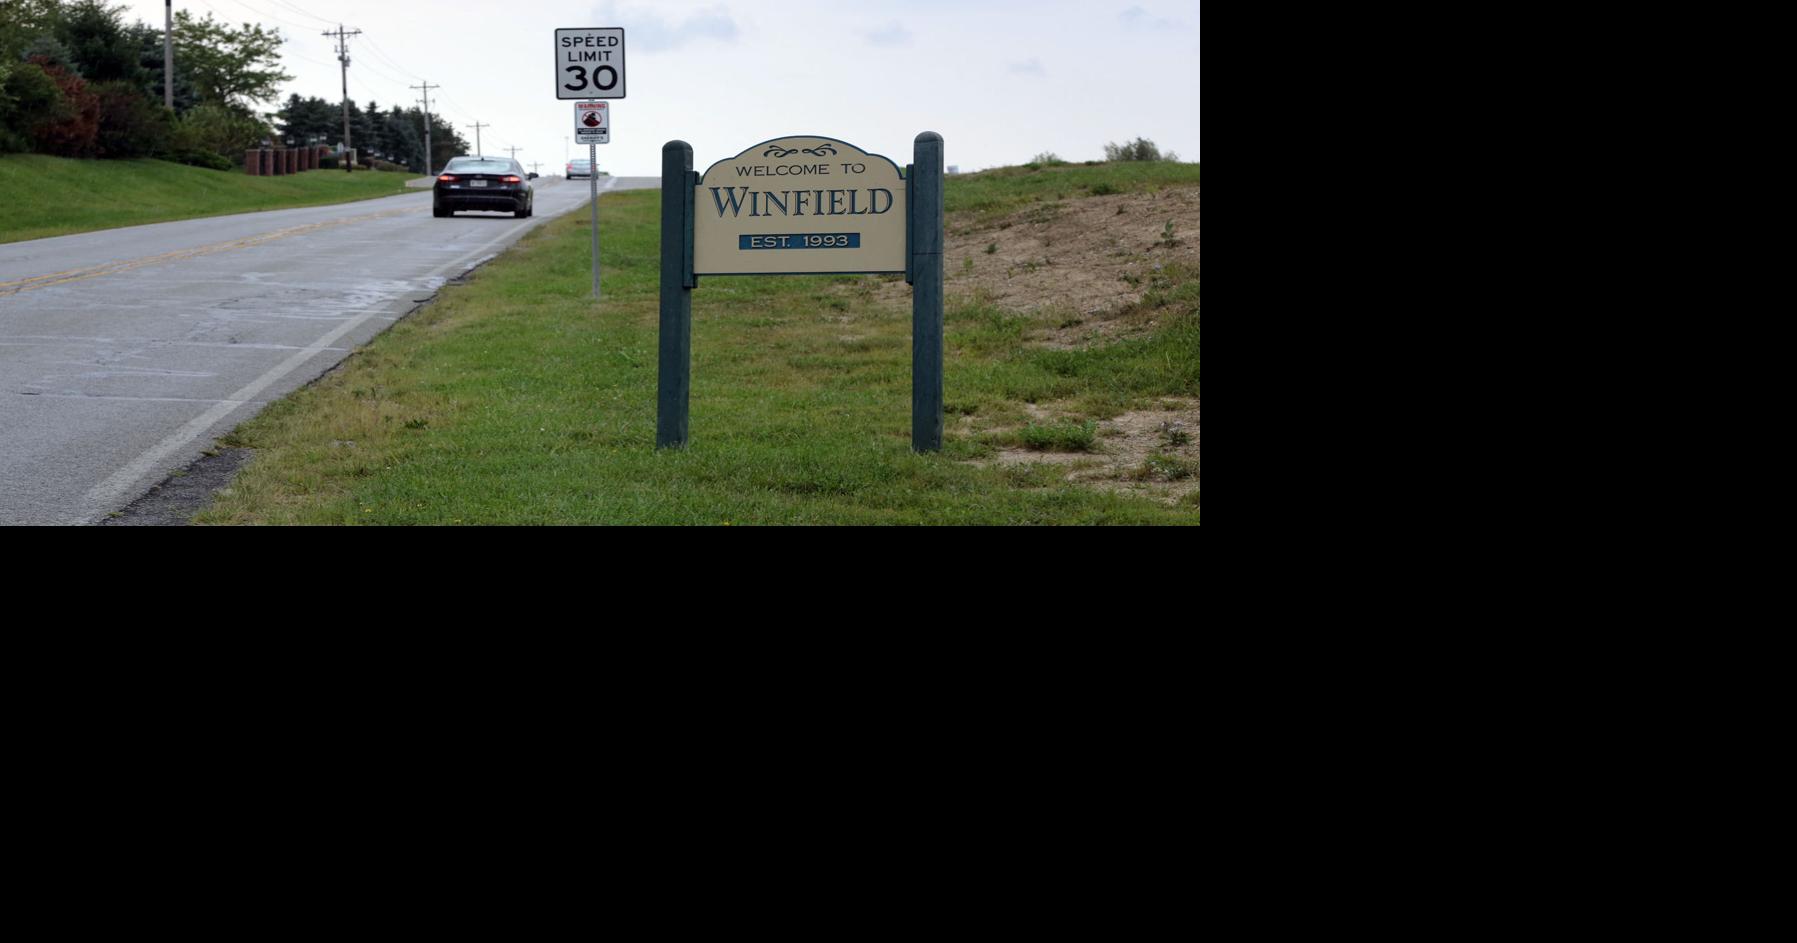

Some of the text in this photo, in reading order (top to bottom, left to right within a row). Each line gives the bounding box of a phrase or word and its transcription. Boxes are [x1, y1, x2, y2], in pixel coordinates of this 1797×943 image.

[561, 36, 619, 48] SPEED
[568, 50, 612, 62] LIMIT
[564, 65, 618, 91] 30
[736, 163, 866, 177] WELCOME TO
[751, 234, 849, 248] EST. 1993
